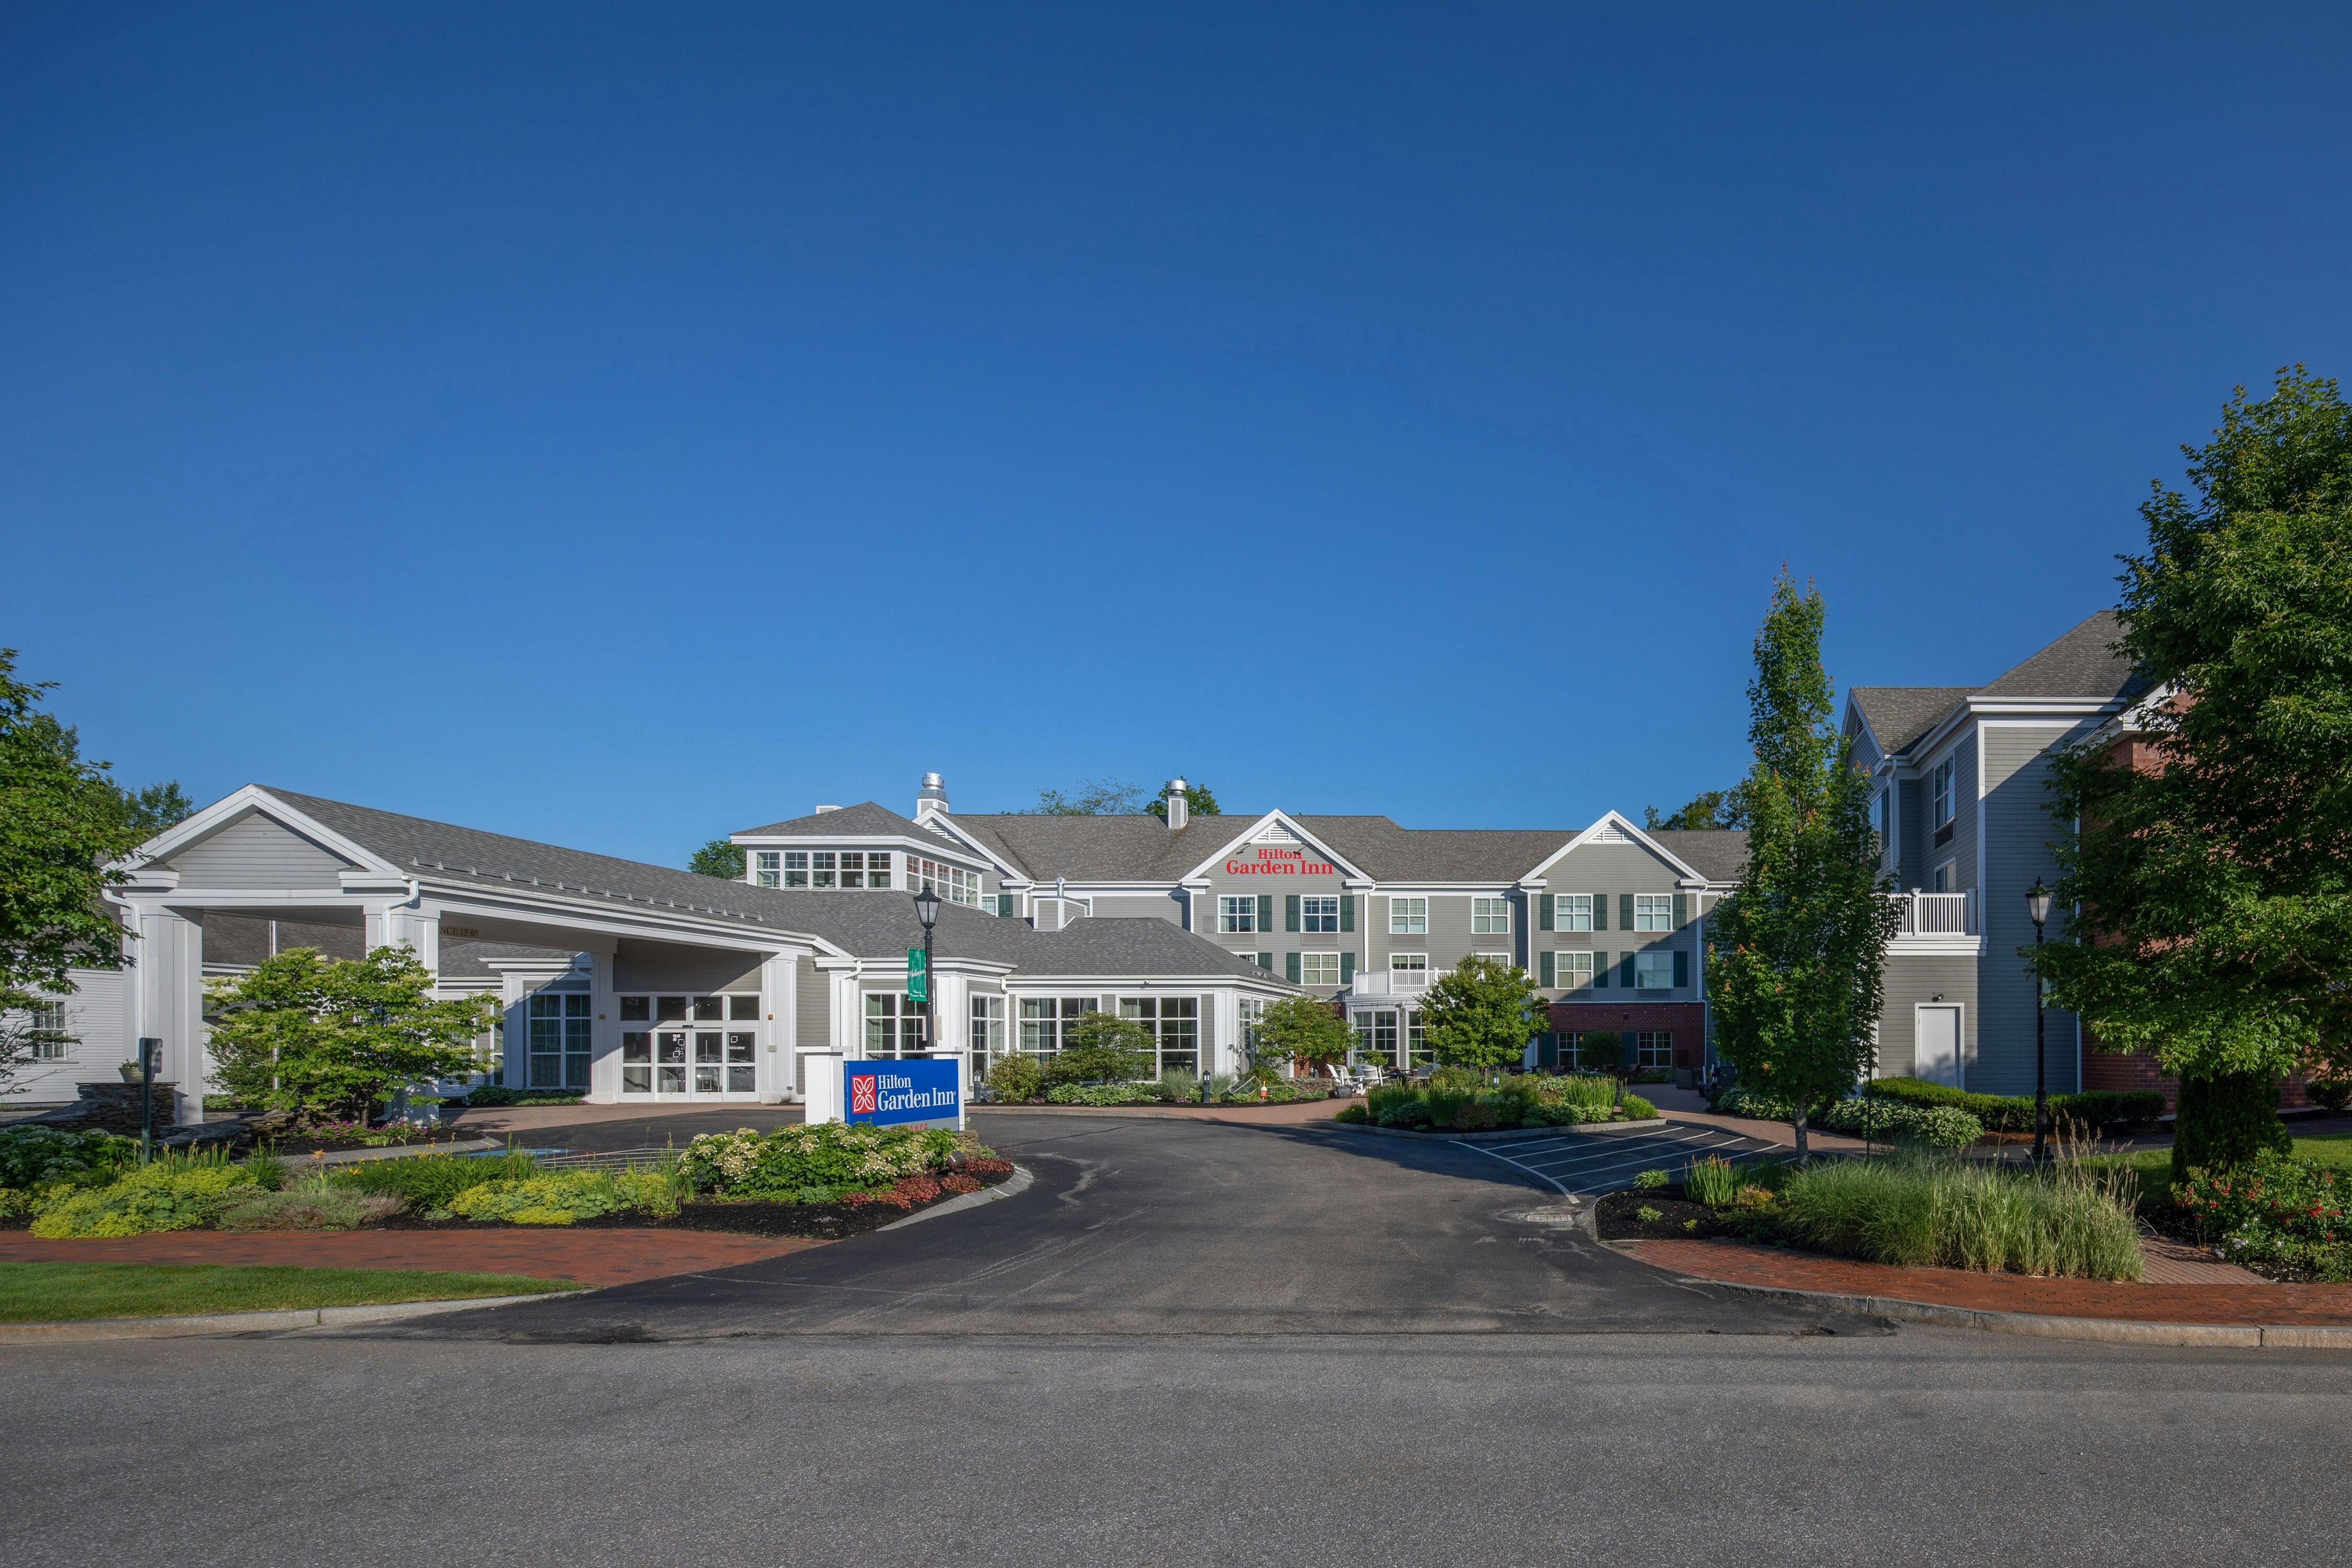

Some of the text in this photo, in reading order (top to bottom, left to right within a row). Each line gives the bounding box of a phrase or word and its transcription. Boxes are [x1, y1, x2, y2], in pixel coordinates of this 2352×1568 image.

[1258, 849, 1302, 859] Hilton
[1226, 860, 1334, 874] Garden Inn
[908, 969, 926, 978] Welcome
[878, 1075, 912, 1090] Hilton
[878, 1089, 931, 1111] Garden
